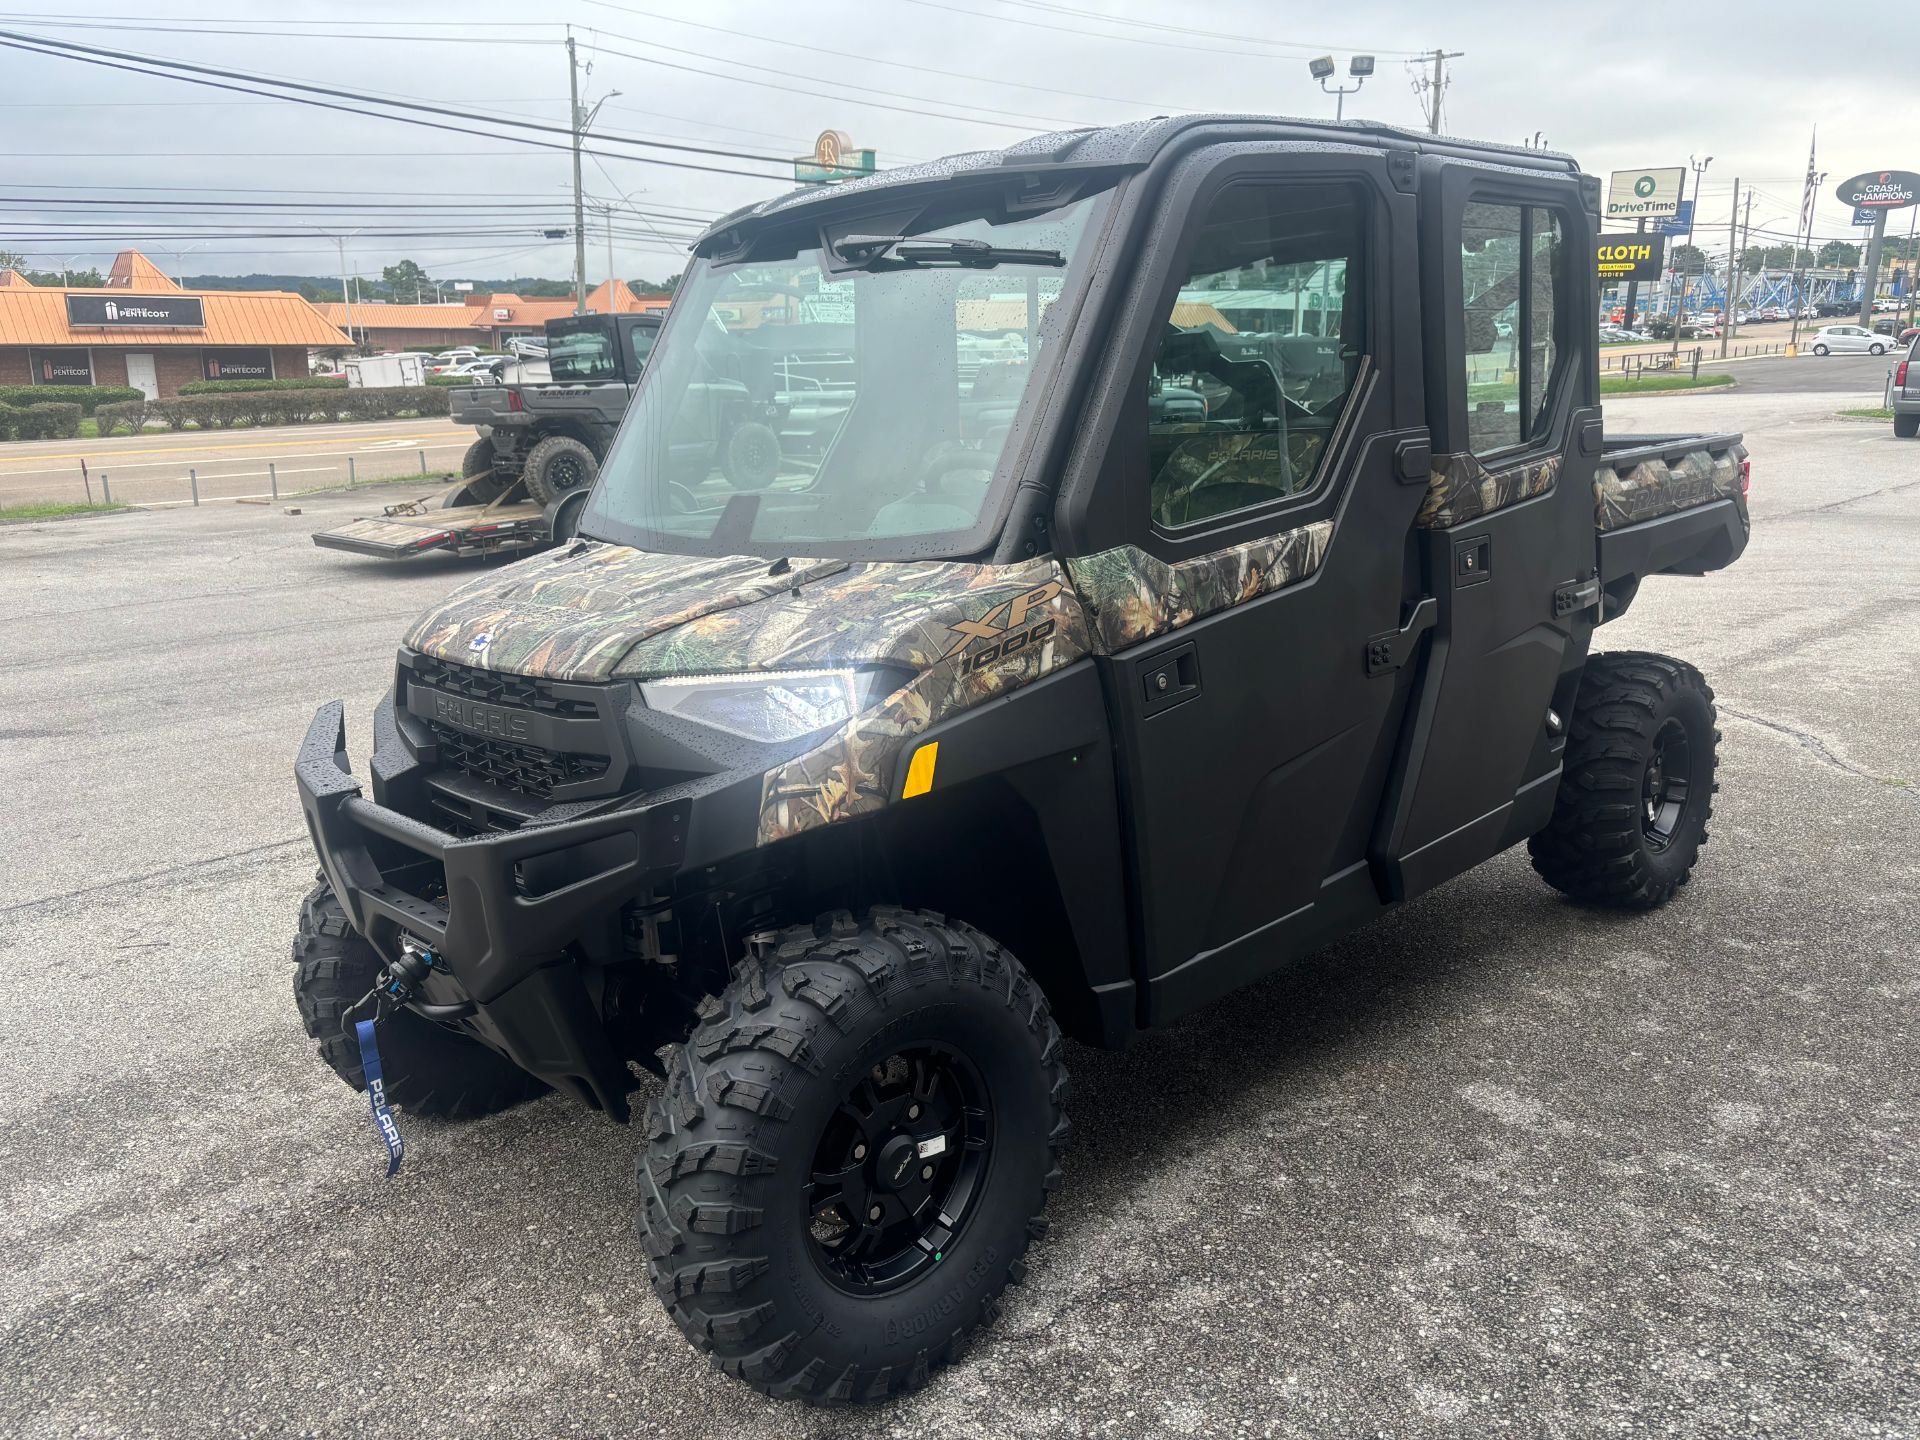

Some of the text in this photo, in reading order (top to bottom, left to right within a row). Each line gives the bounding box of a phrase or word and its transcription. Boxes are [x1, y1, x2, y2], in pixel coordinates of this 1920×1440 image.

[1852, 191, 1913, 201] CHAMPIONS
[1866, 184, 1902, 193] CRASH
[1609, 200, 1676, 213] DriveTime
[1598, 245, 1651, 260] CLOTH
[120, 310, 170, 318] PENTECOST
[1208, 449, 1279, 462] POLARIS
[1632, 478, 1715, 512] RANGER
[934, 580, 1064, 664] XP
[961, 618, 1056, 676] 1000
[435, 695, 528, 740] POLARIS
[369, 1078, 403, 1159] POLARIS
